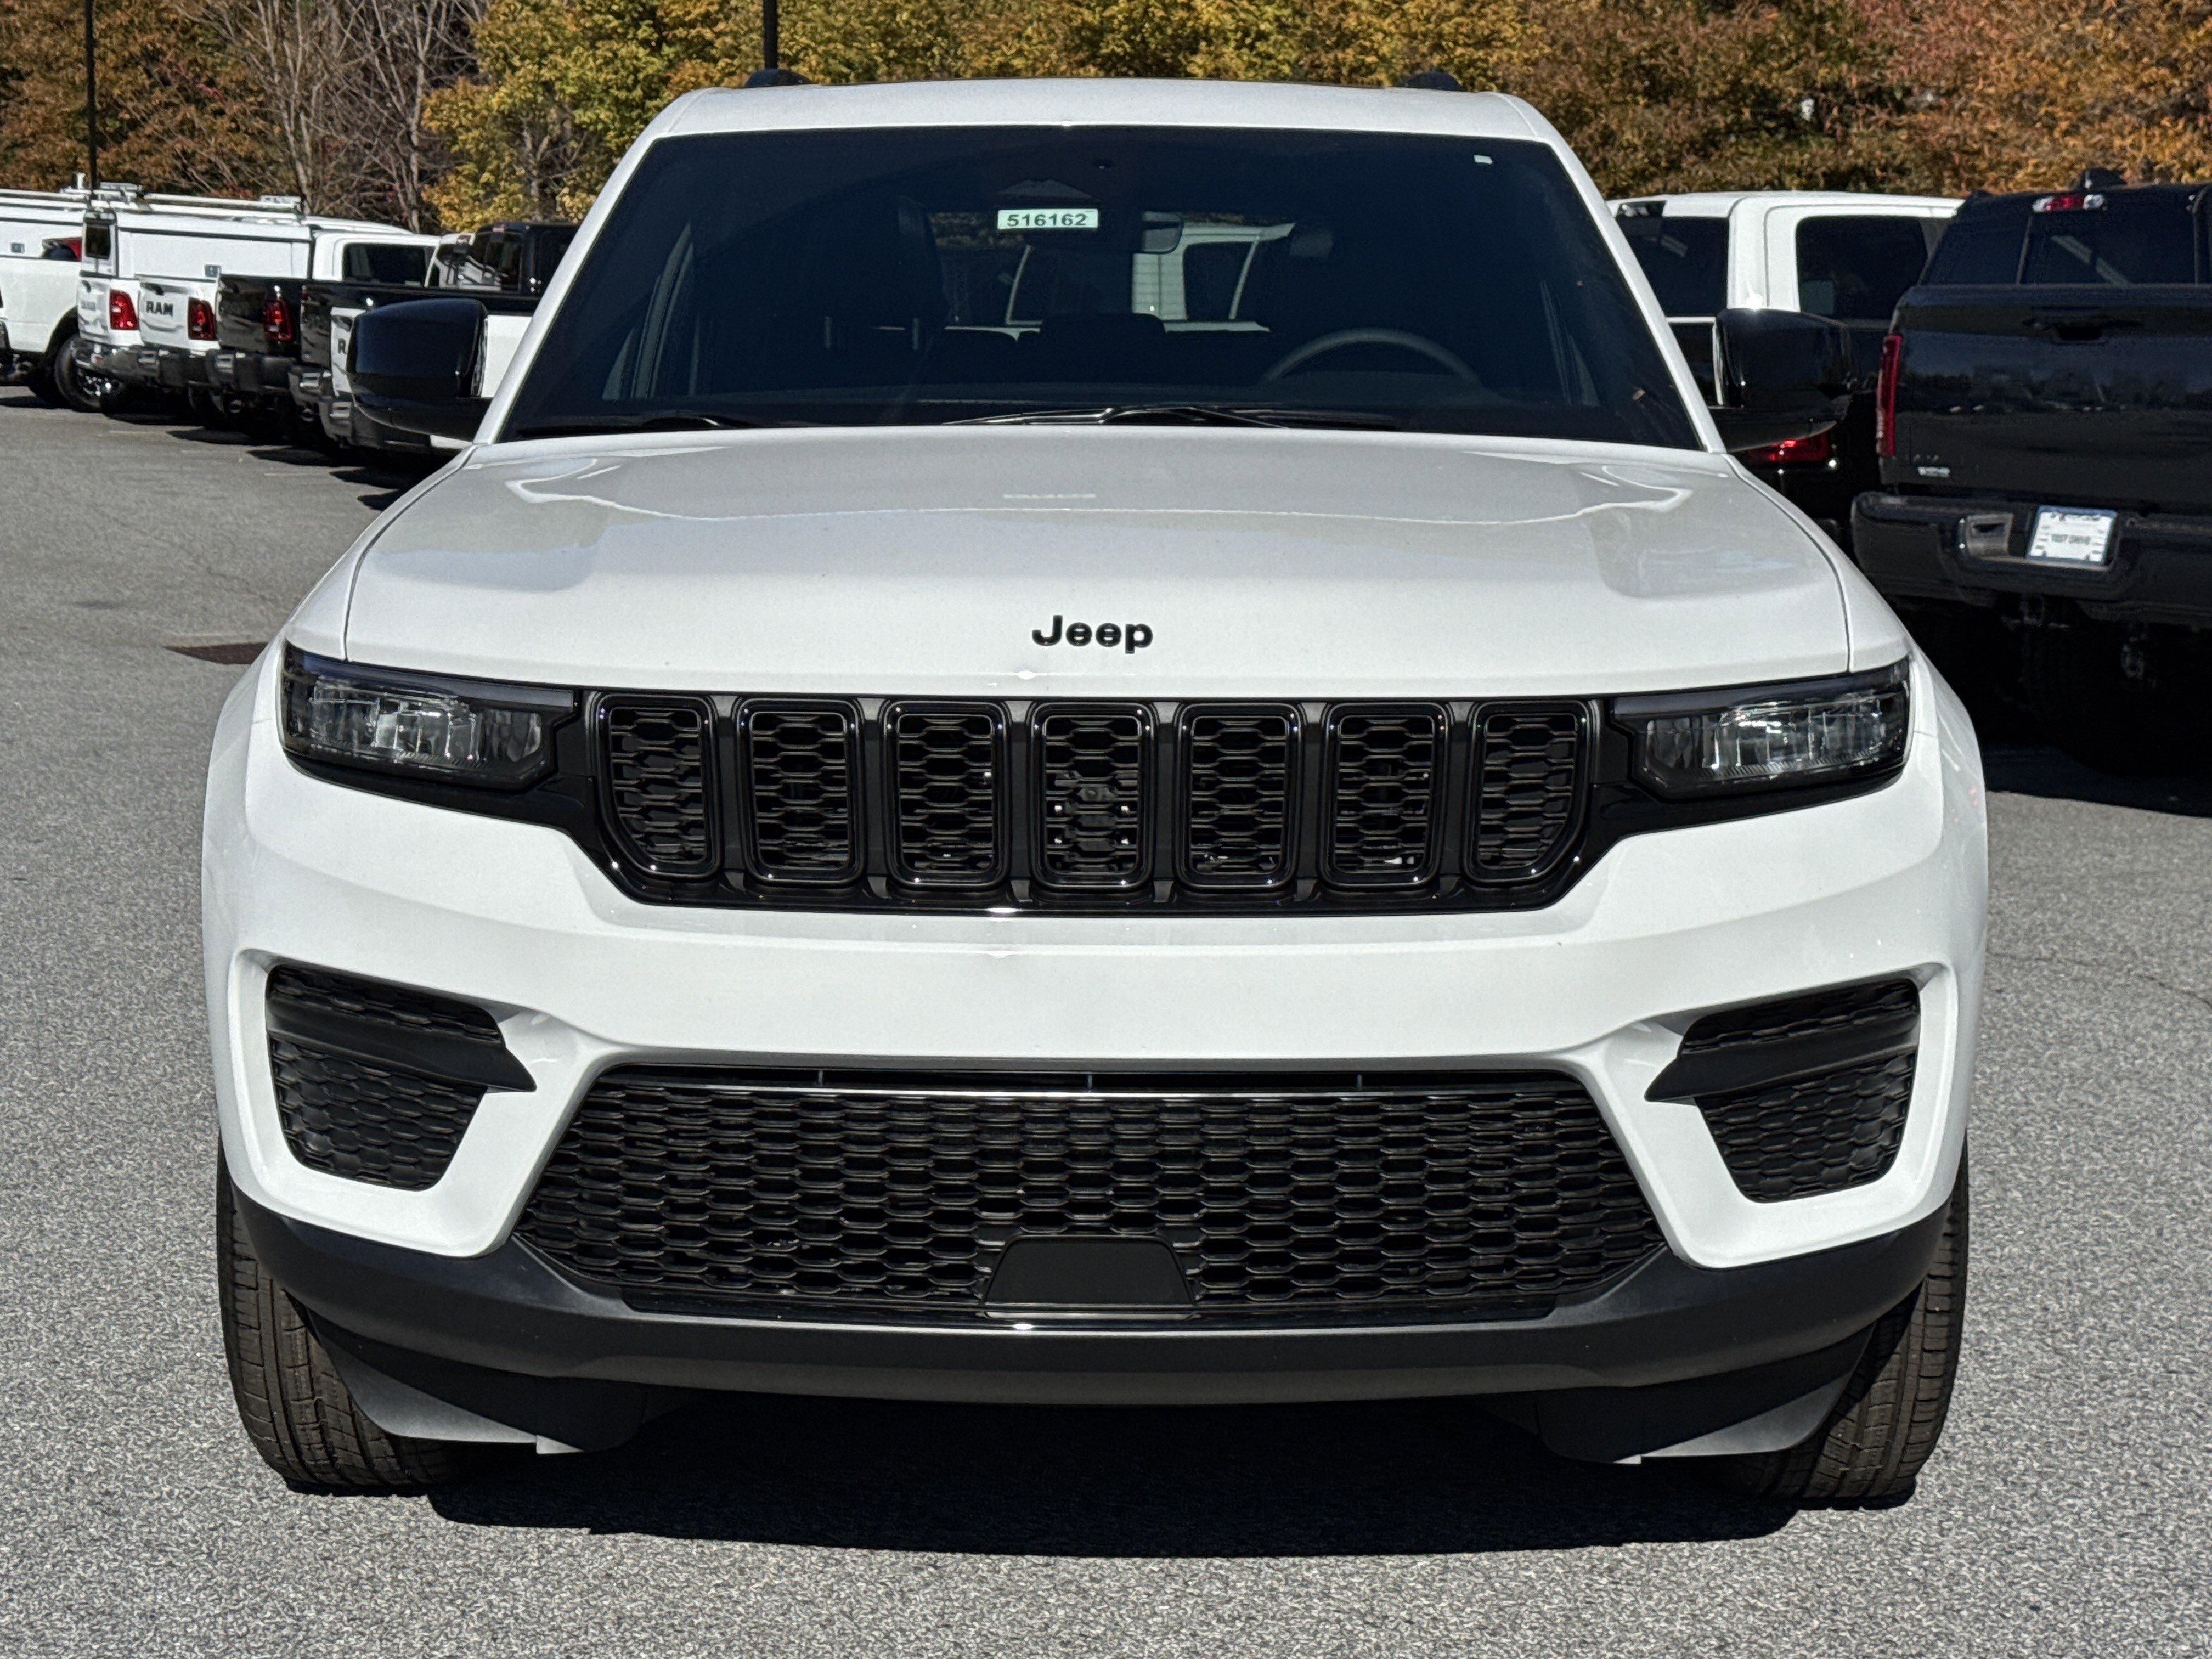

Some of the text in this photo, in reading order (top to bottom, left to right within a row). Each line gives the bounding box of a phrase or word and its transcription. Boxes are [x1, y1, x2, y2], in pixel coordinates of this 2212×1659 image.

[1007, 213, 1087, 227] 516162
[145, 301, 173, 317] RAM
[1032, 614, 1153, 654] Jeep
